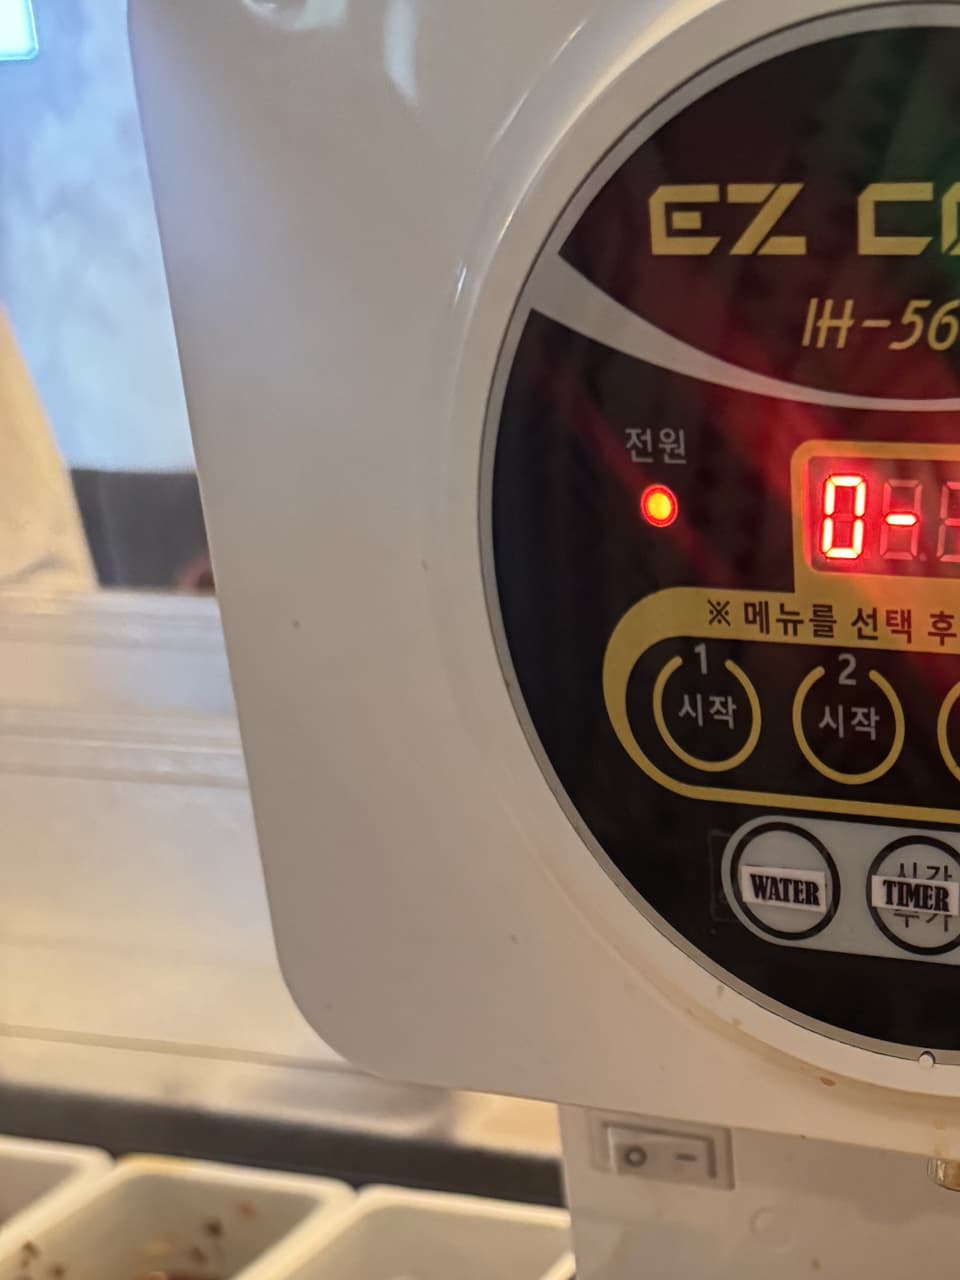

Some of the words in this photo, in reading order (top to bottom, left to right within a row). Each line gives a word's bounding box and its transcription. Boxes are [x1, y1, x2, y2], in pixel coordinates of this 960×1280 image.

[648, 182, 808, 256] EZ
[625, 427, 687, 464] 전원
[743, 600, 838, 639] 메뉴를
[850, 606, 913, 644] 선택
[927, 610, 958, 646] 후
[693, 642, 708, 675] 1
[837, 653, 858, 686] 2
[677, 692, 738, 730] 시작
[818, 703, 881, 741] 시작
[749, 872, 821, 907] WATER
[881, 878, 951, 913] TIMER
